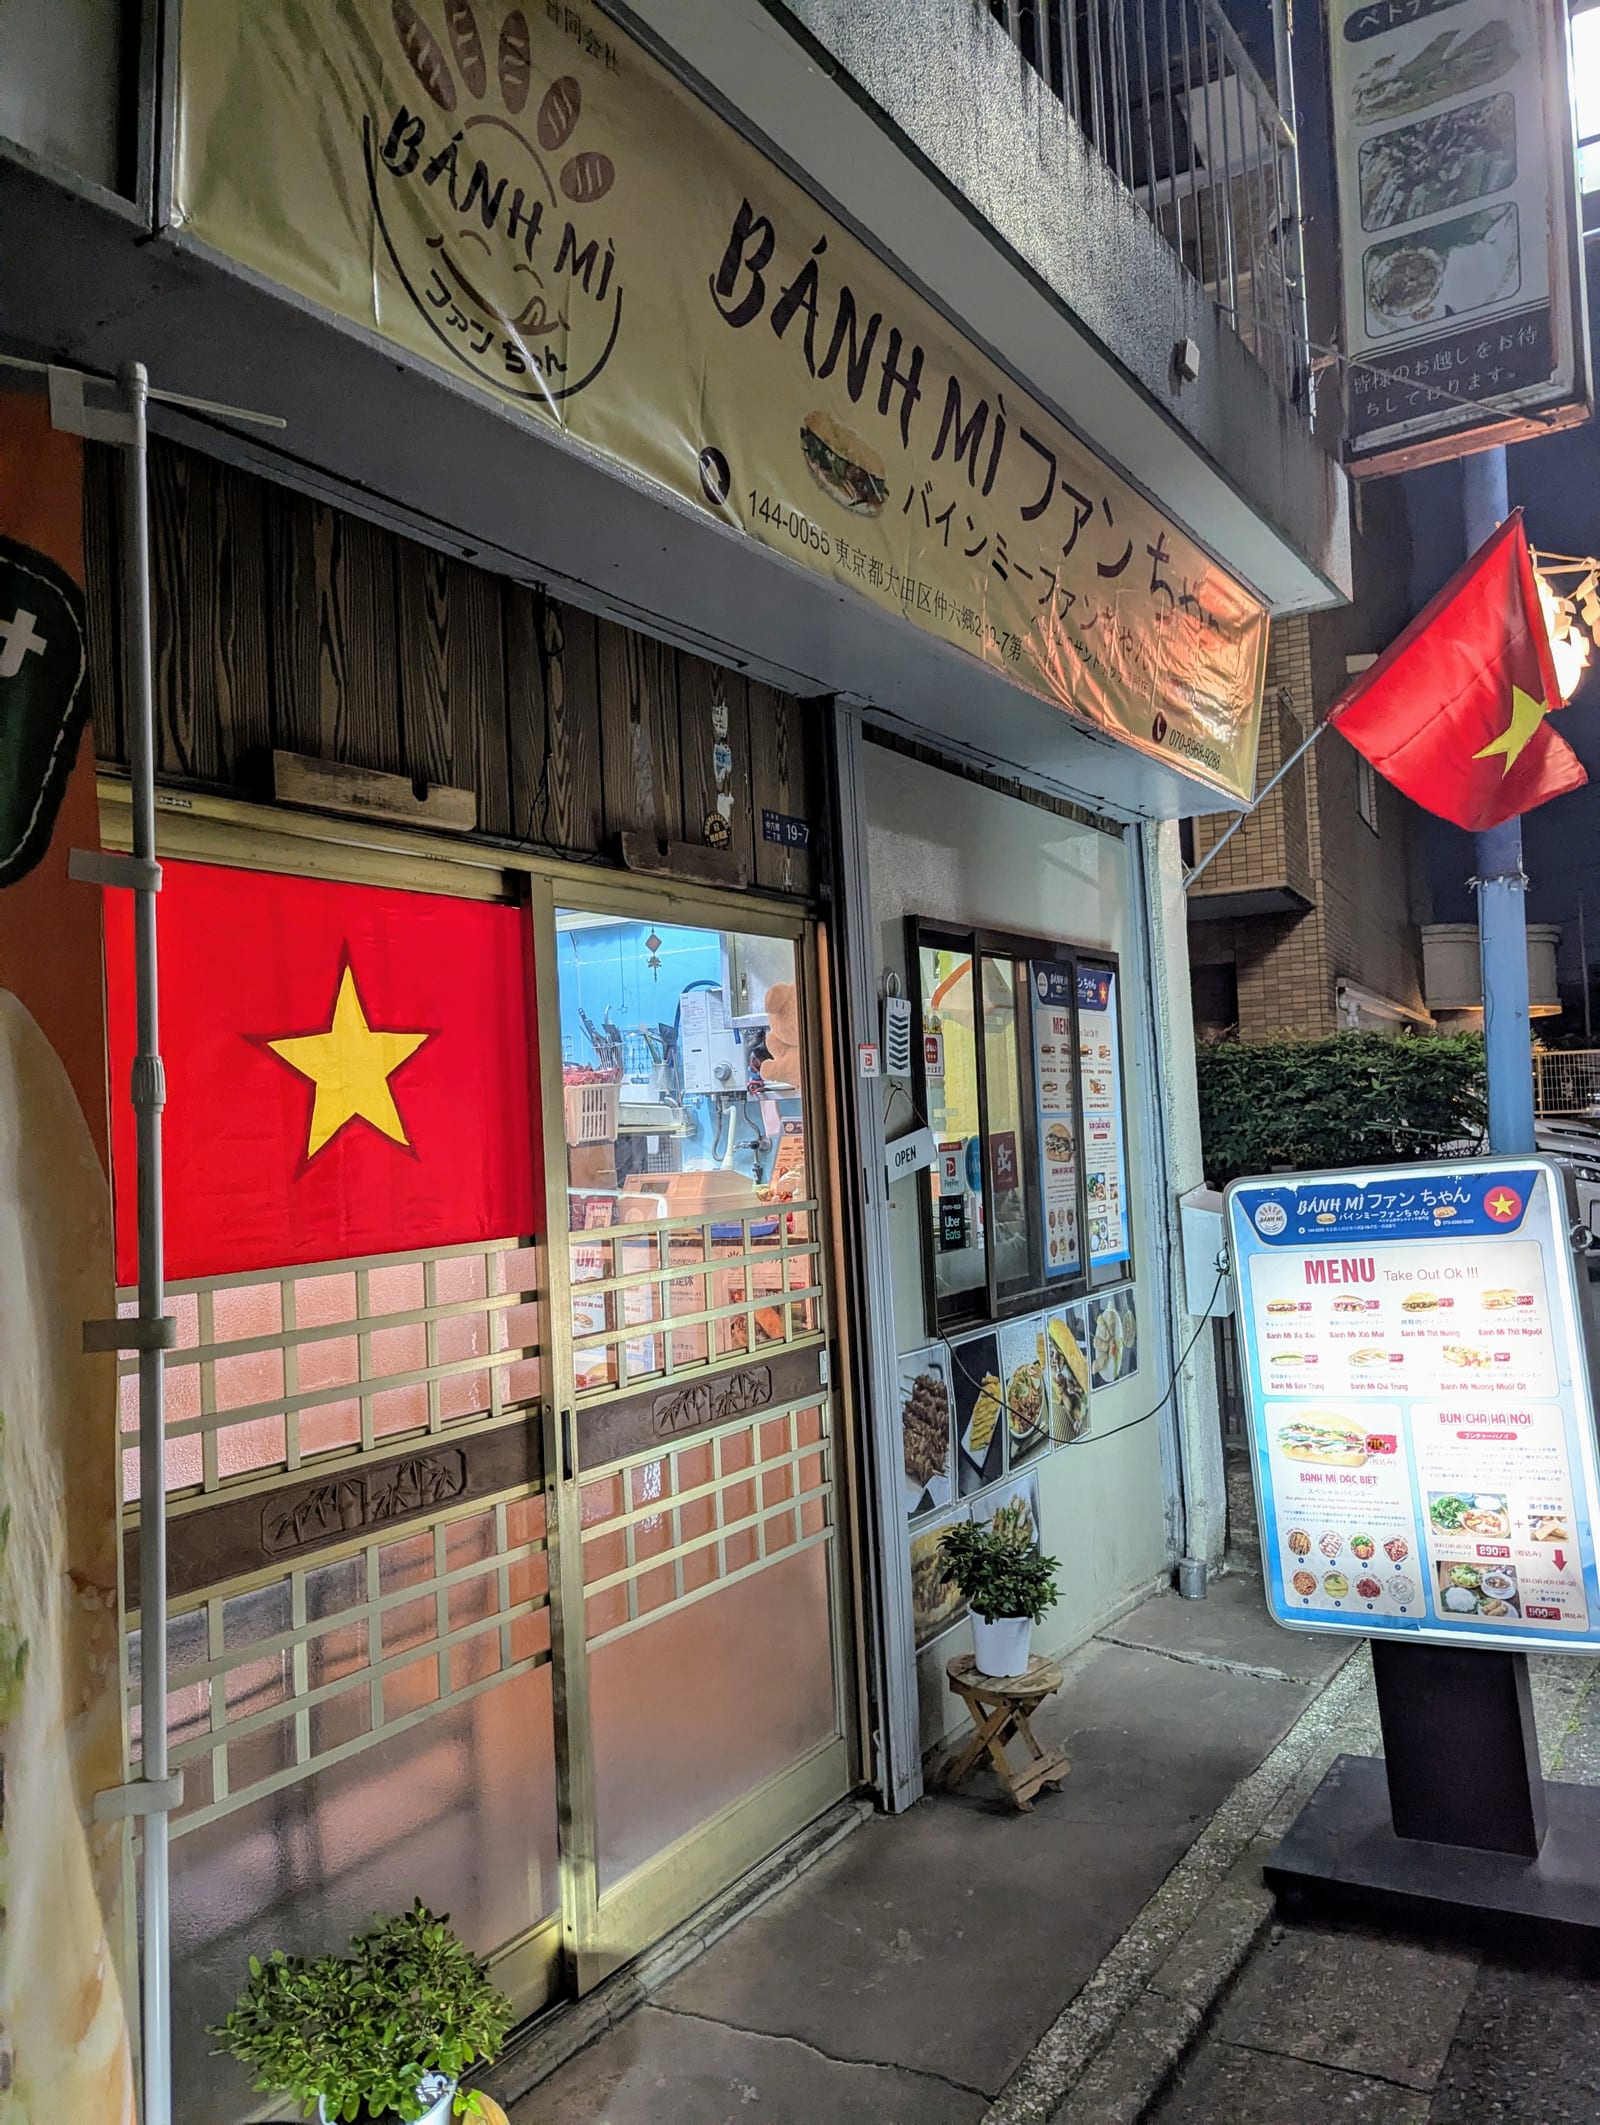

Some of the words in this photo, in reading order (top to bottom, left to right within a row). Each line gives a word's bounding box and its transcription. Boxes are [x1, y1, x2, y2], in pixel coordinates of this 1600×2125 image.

[380, 105, 544, 262] BÁNH
[554, 222, 616, 301] MÌ
[710, 198, 924, 449] BÁNH
[932, 375, 1006, 497] MÌ
[748, 490, 831, 556] 144-0055
[786, 823, 810, 844] 19-7
[895, 1145, 917, 1168] OPEN
[1297, 1196, 1340, 1215] BÁNH
[1344, 1194, 1365, 1211] MÌ
[1339, 1208, 1430, 1221] バインミーファンちゃん
[945, 1216, 960, 1228] Uber
[945, 1229, 961, 1241] Eats
[1304, 1258, 1376, 1284] MENU
[1384, 1271, 1413, 1281] Take
[1417, 1268, 1441, 1281] Out
[1444, 1267, 1463, 1279] Ok
[1466, 1267, 1479, 1279] !!!
[1479, 1545, 1509, 1557] 890円
